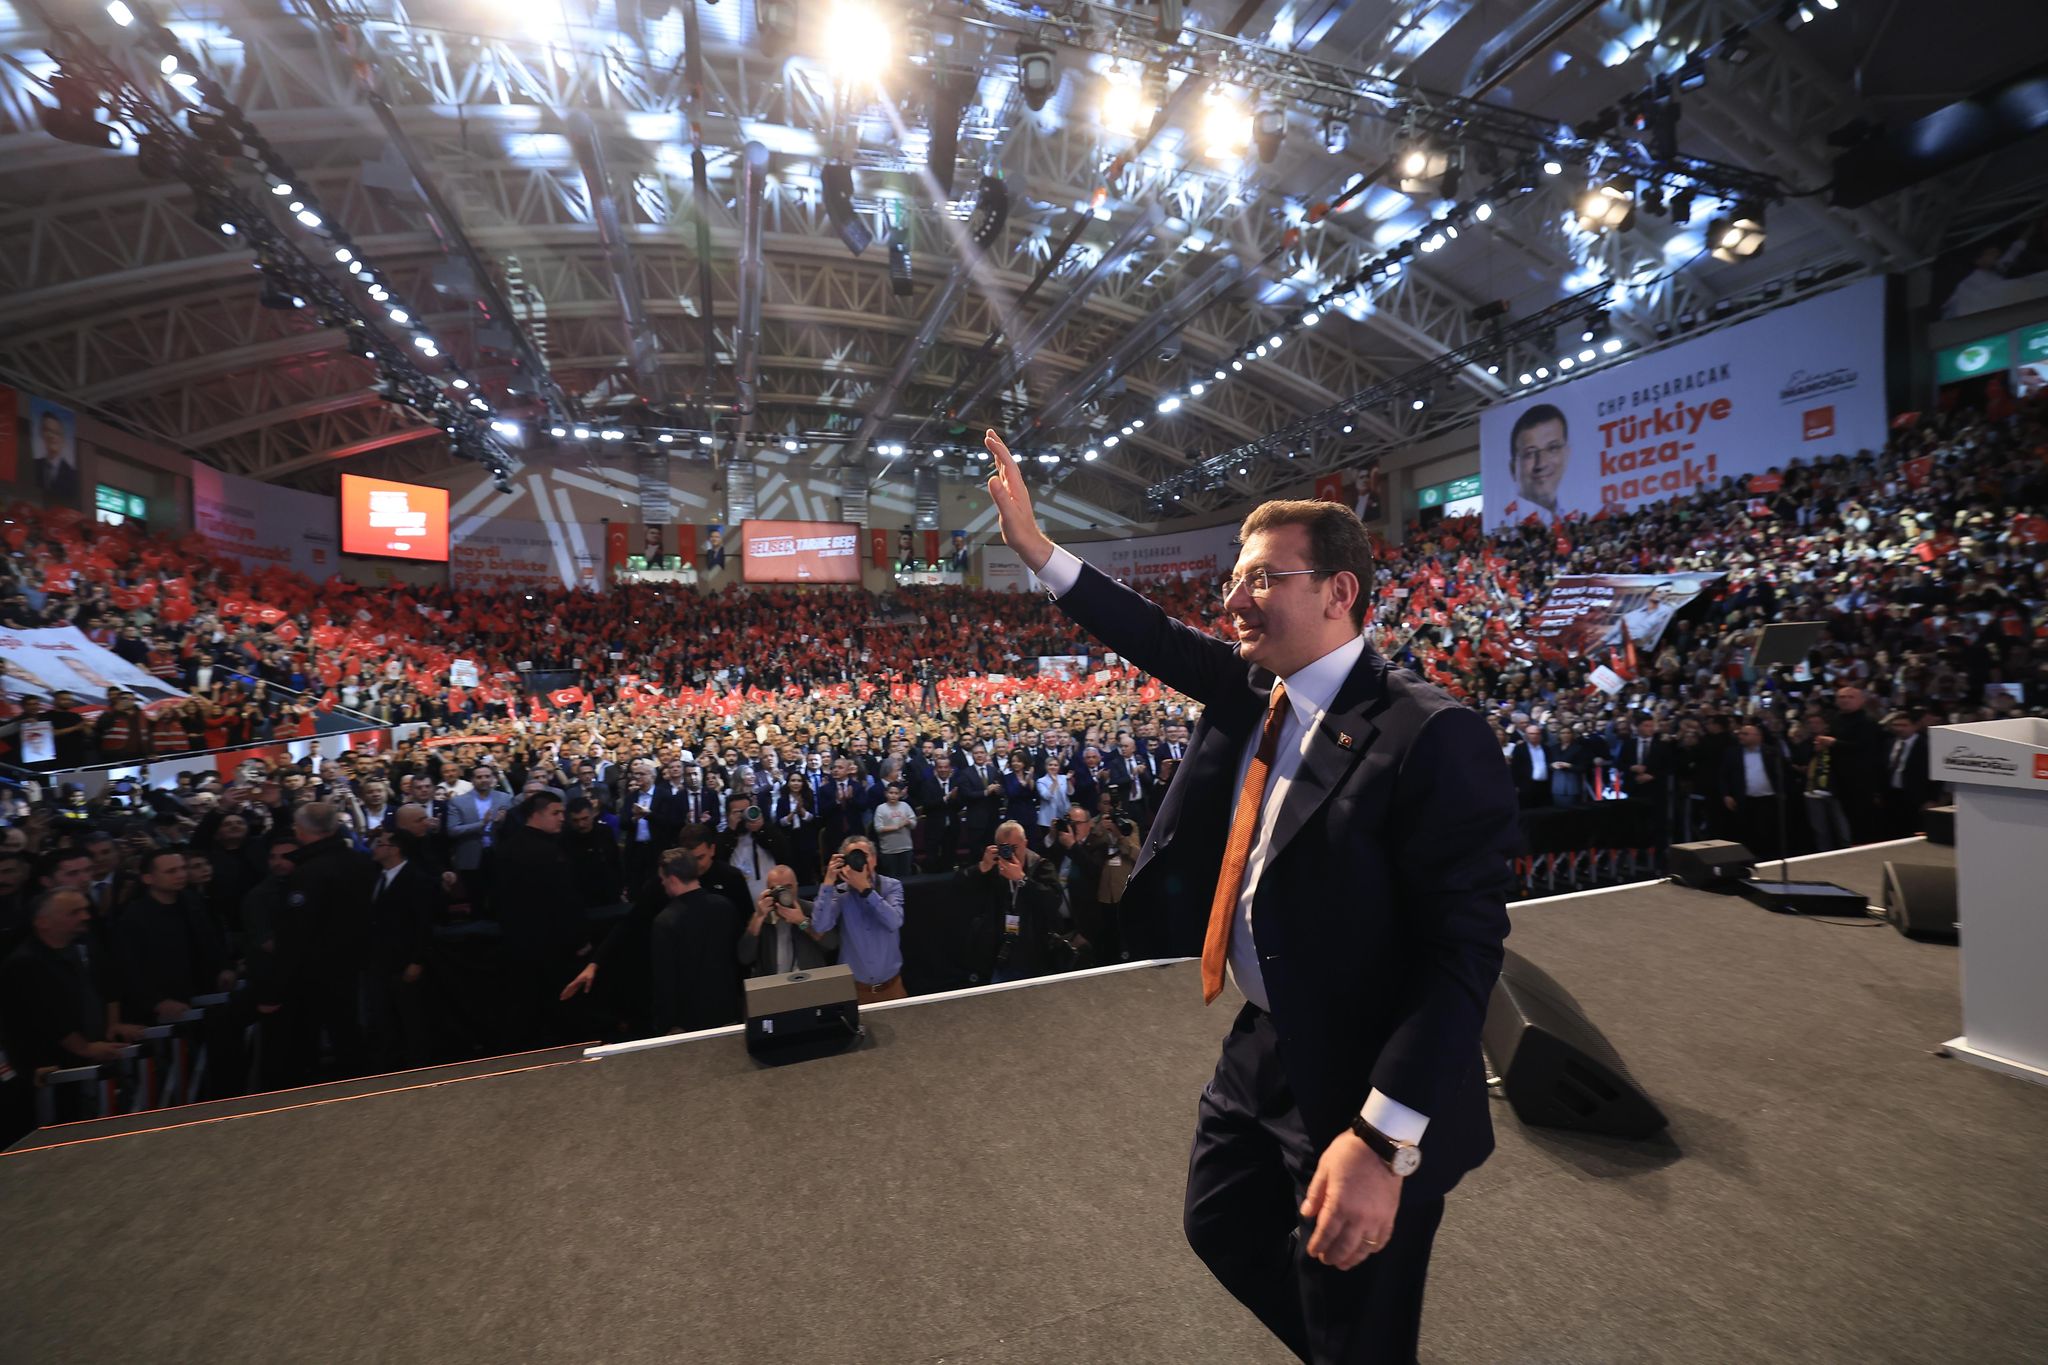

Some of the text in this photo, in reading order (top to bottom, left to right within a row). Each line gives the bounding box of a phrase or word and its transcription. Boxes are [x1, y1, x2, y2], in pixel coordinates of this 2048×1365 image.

[1597, 363, 1731, 417] CHP BAŞARACAK
[1598, 397, 1732, 448] Türkiye
[1600, 440, 1695, 477] kaza-
[1601, 453, 1717, 505] nacak!
